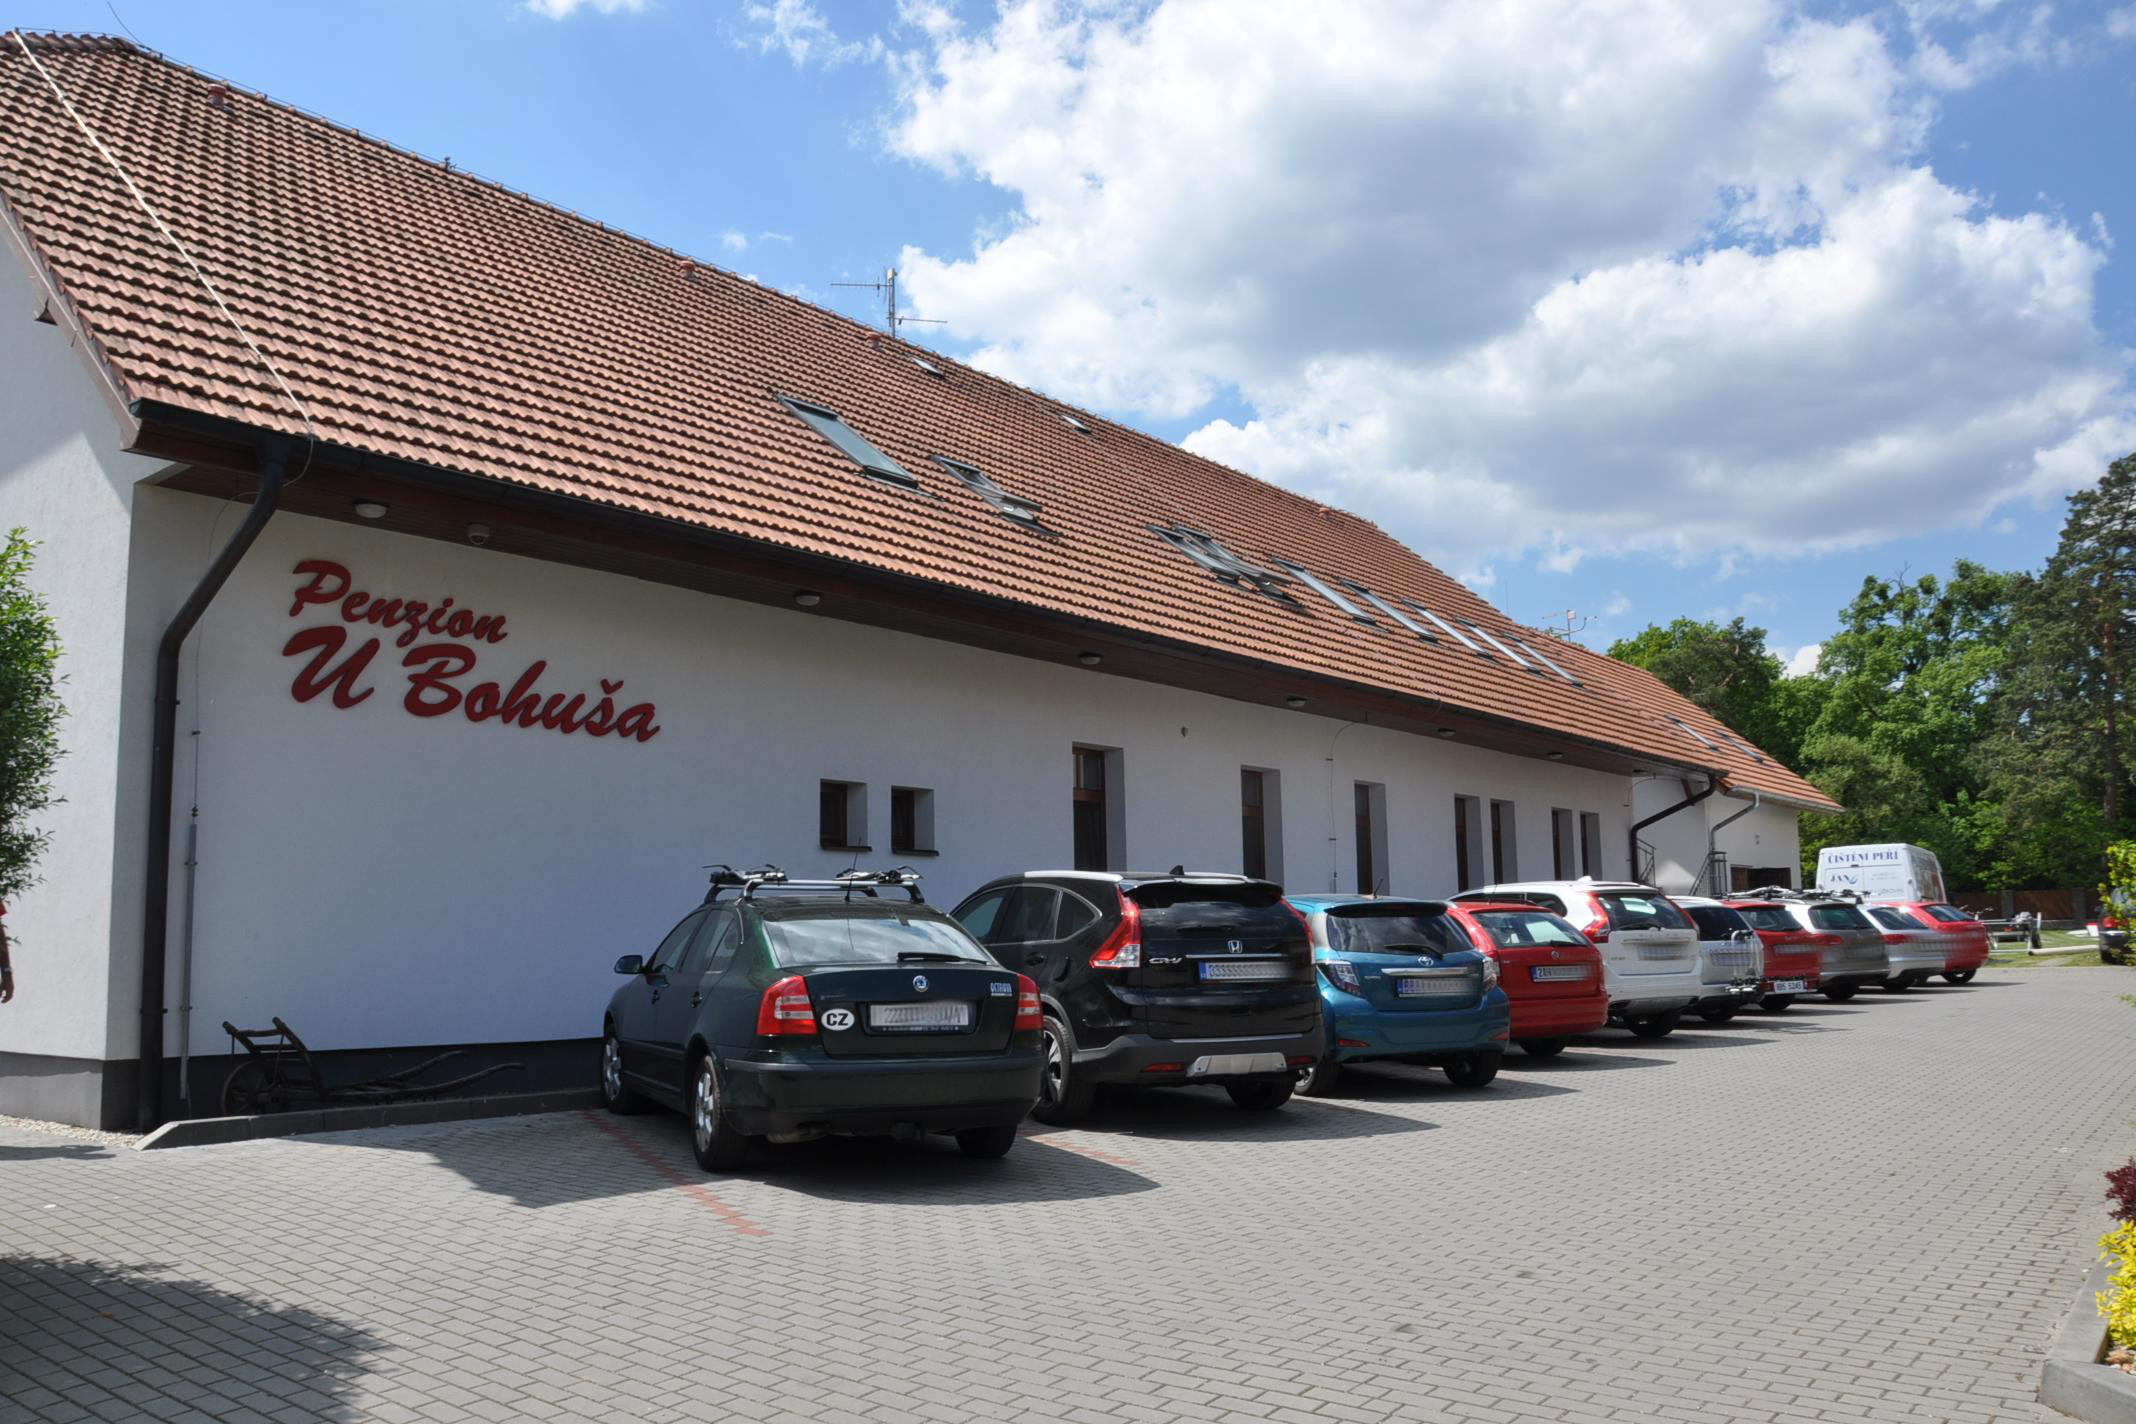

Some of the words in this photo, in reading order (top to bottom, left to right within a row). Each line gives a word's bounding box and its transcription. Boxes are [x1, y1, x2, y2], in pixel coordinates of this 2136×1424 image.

[290, 559, 508, 648] Penzion
[282, 625, 380, 709] U
[402, 643, 661, 742] Bohuša
[826, 1012, 849, 1026] CZ
